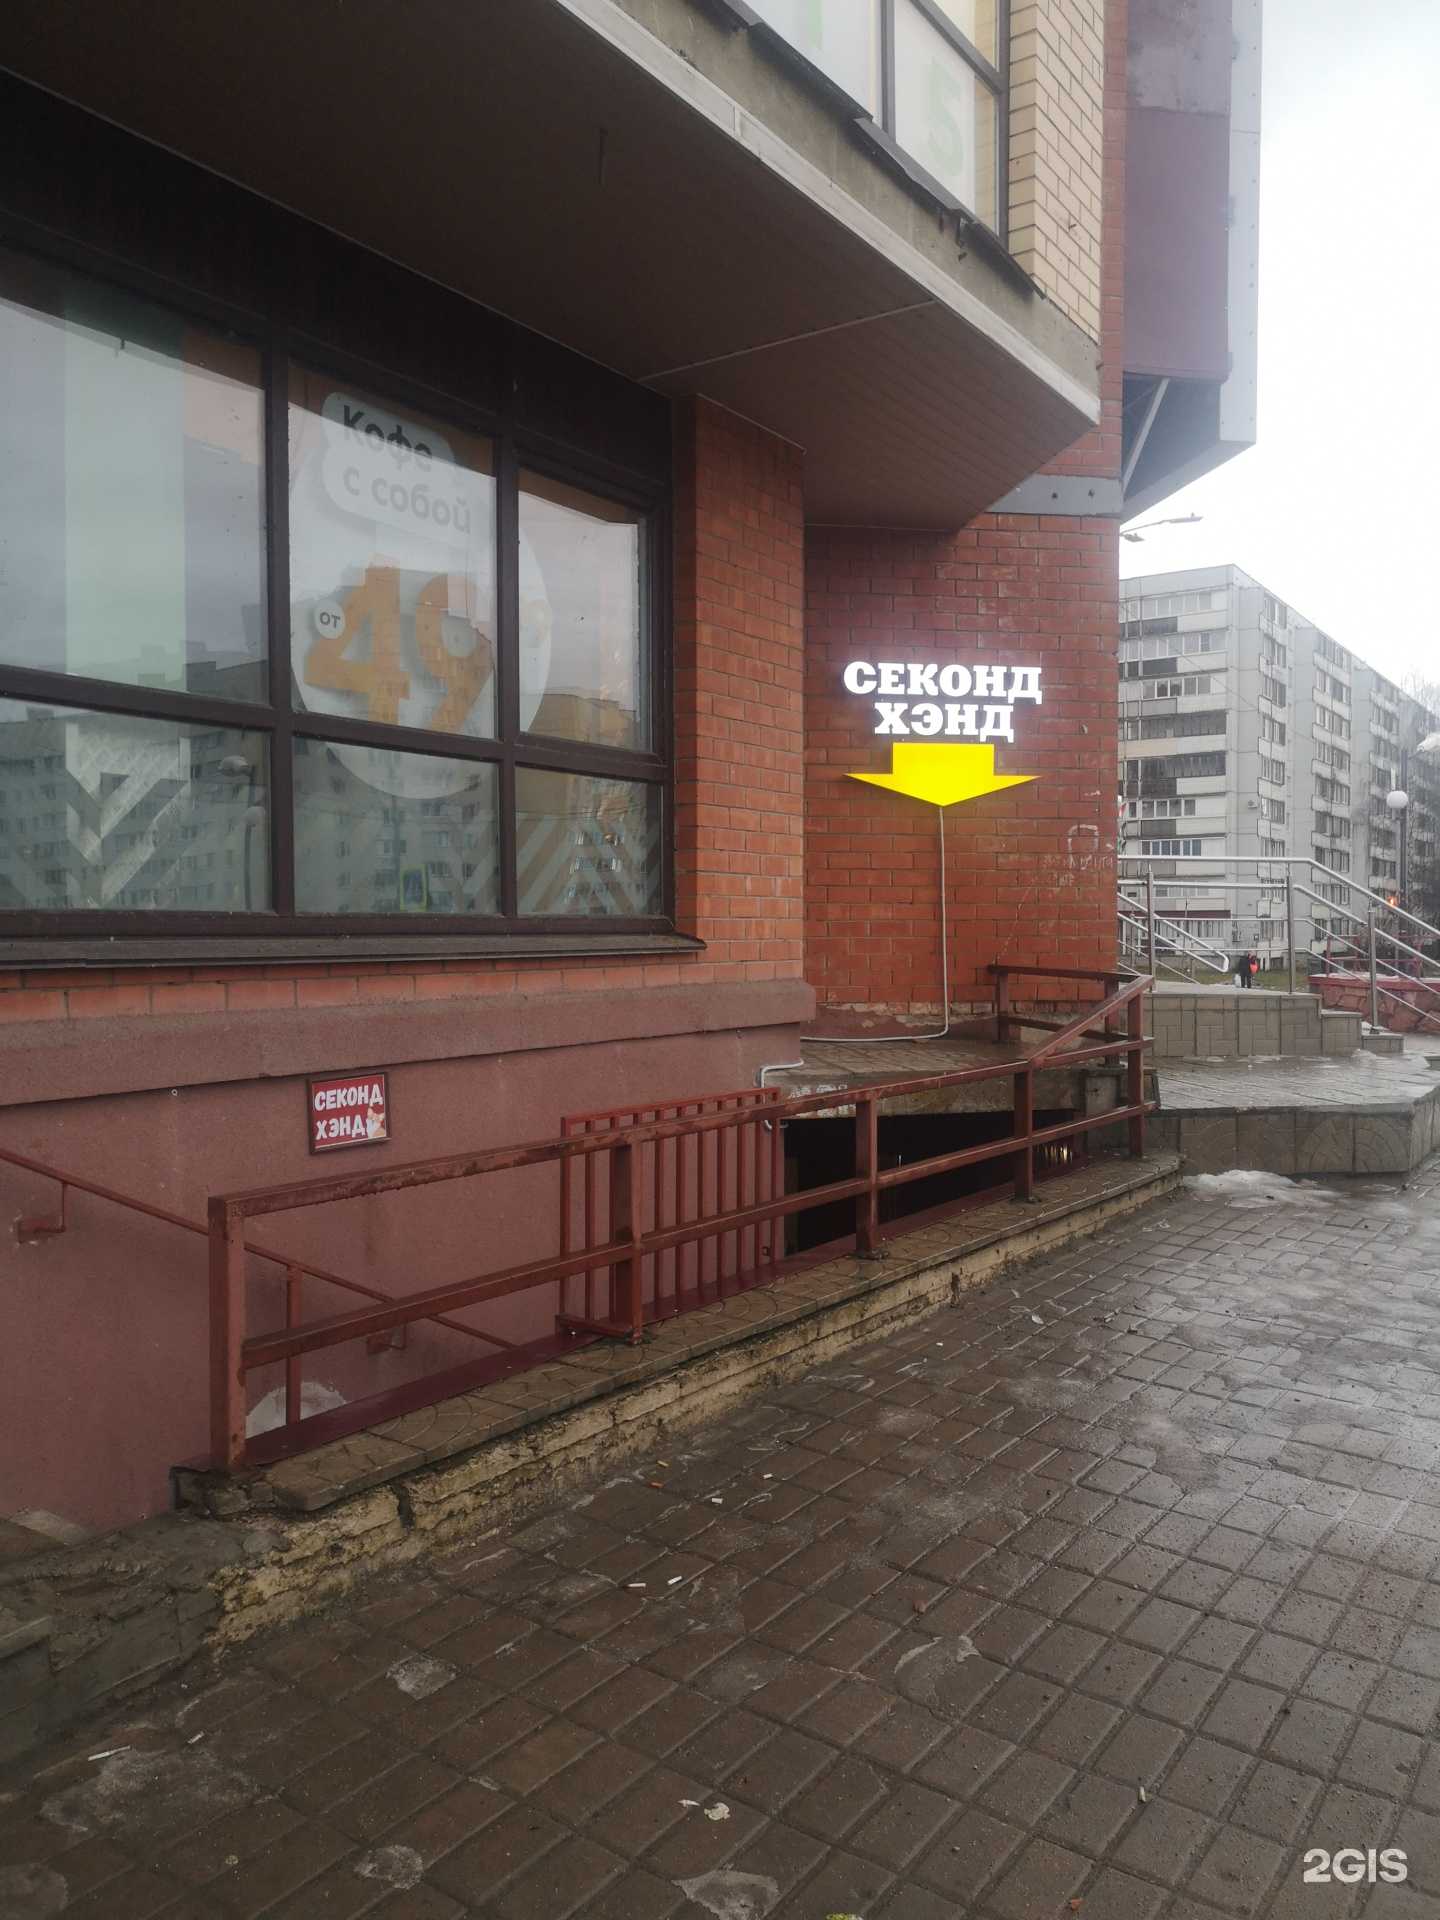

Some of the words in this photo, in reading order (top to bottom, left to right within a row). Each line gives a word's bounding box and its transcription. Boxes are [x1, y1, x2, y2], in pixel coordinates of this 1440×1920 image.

[343, 404, 434, 472] Кофе
[343, 465, 361, 497] с
[371, 477, 471, 535] собой
[303, 553, 496, 736] 49
[843, 661, 1042, 704] СЕКОНД
[874, 702, 1014, 743] ХЭНД
[314, 1083, 383, 1112] СЕКОНД
[316, 1114, 366, 1140] ХЭНД
